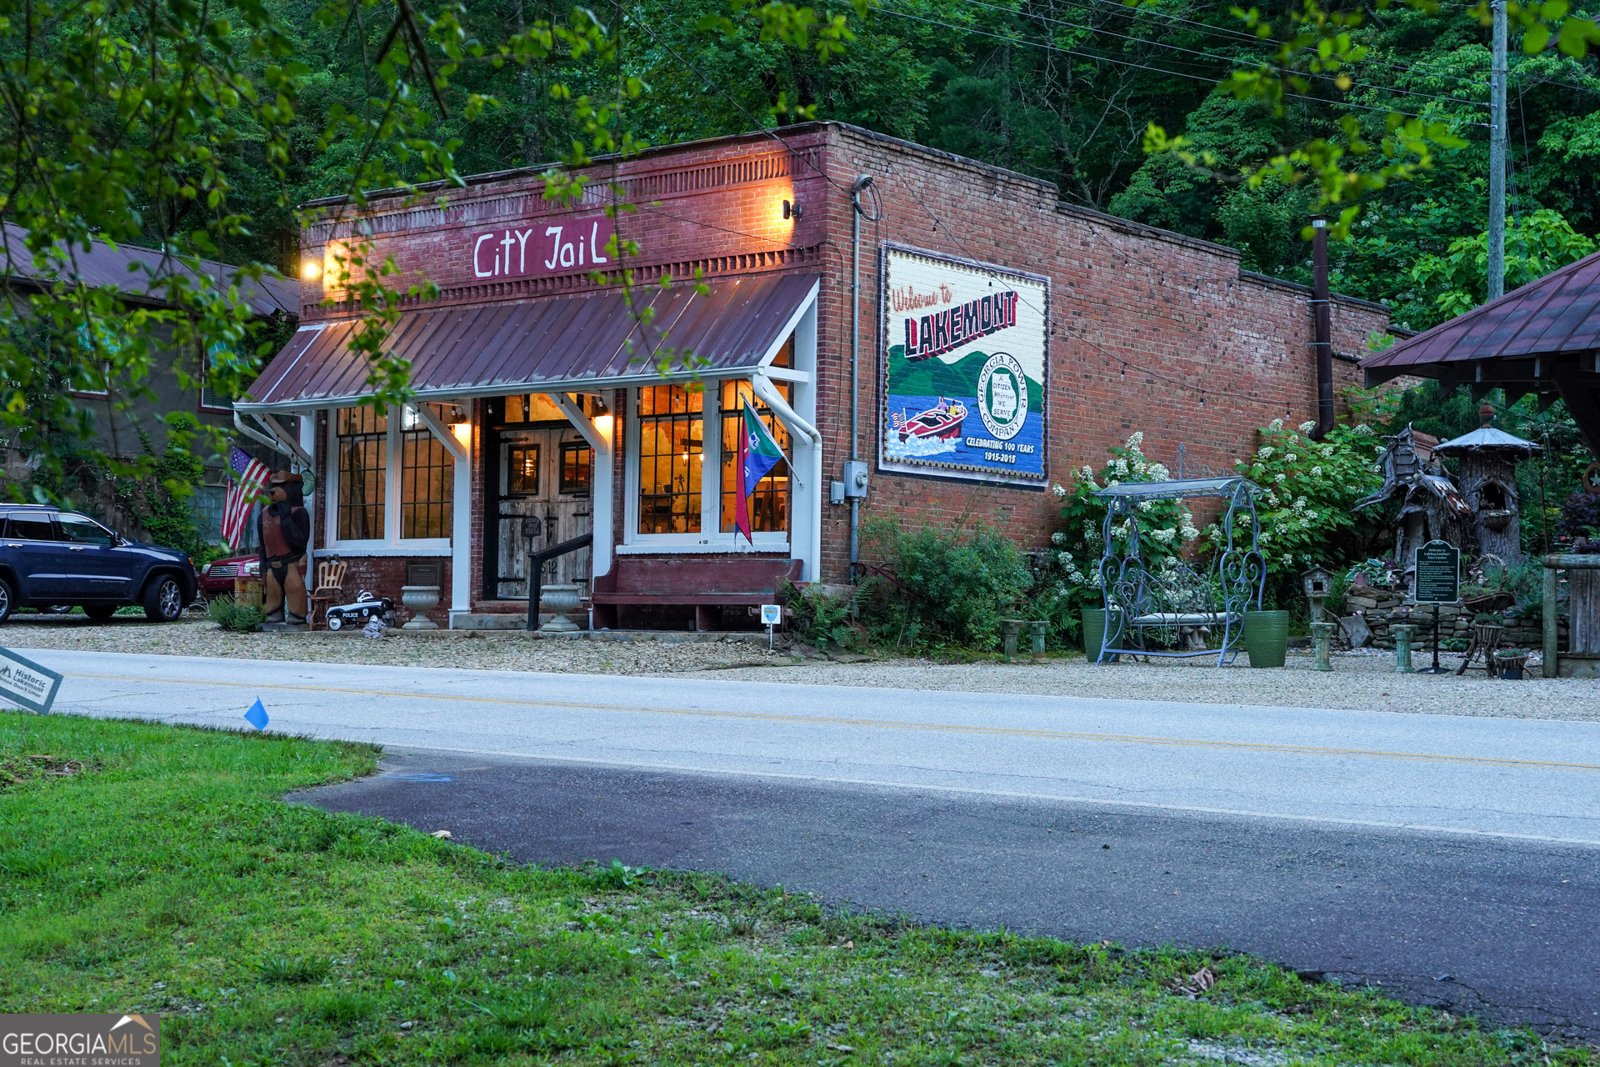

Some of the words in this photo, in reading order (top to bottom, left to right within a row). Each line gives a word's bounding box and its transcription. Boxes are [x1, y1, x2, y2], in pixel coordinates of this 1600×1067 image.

[892, 286, 938, 312] Welcome
[938, 283, 952, 304] to
[904, 290, 1019, 362] LAKEMONT
[978, 355, 1004, 403] GEORGIA
[1007, 358, 1027, 409] POWER
[993, 408, 1011, 416] SERVE
[982, 412, 1020, 437] COMPANY
[966, 437, 1003, 450] CELEBRATING
[1004, 442, 1016, 451] 100
[1016, 444, 1035, 454] YEARS
[984, 451, 1016, 464] 1915-2015
[13, 676, 44, 693] Lakemont
[15, 669, 46, 688] Historic
